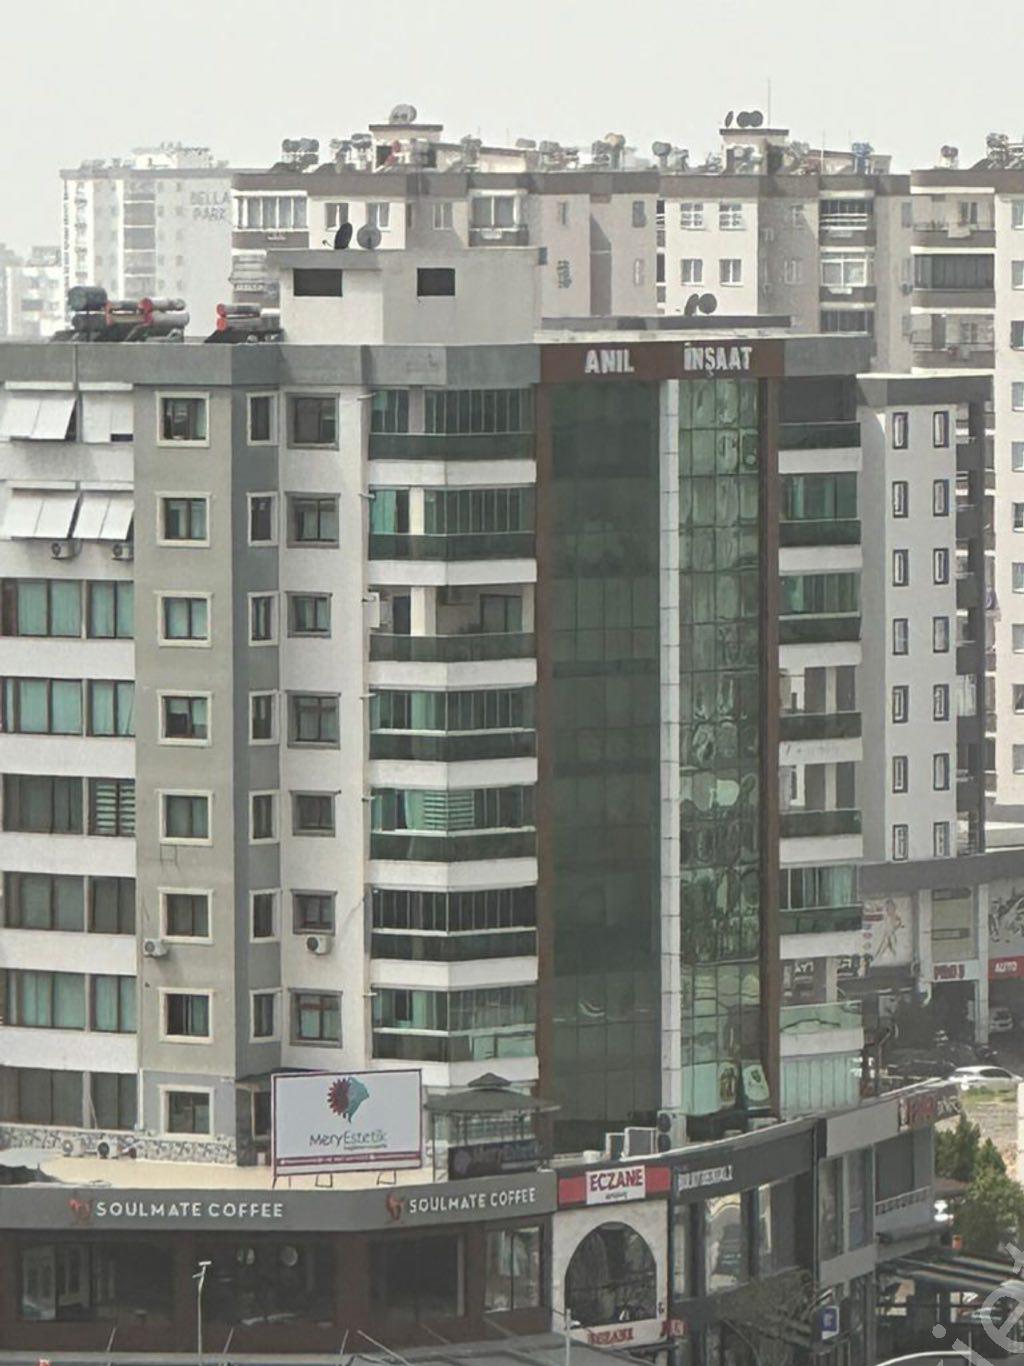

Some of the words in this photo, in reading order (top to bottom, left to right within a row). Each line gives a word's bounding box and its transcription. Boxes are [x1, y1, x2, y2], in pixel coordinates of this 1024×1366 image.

[584, 349, 635, 374] ANIL
[683, 342, 753, 377] İNŞAAT
[590, 1168, 643, 1192] ECZANE
[97, 1201, 201, 1218] SOULMATE
[208, 1202, 284, 1218] COFFEE
[409, 1192, 487, 1214] SOULMATE
[489, 1187, 537, 1206] COFFEE
